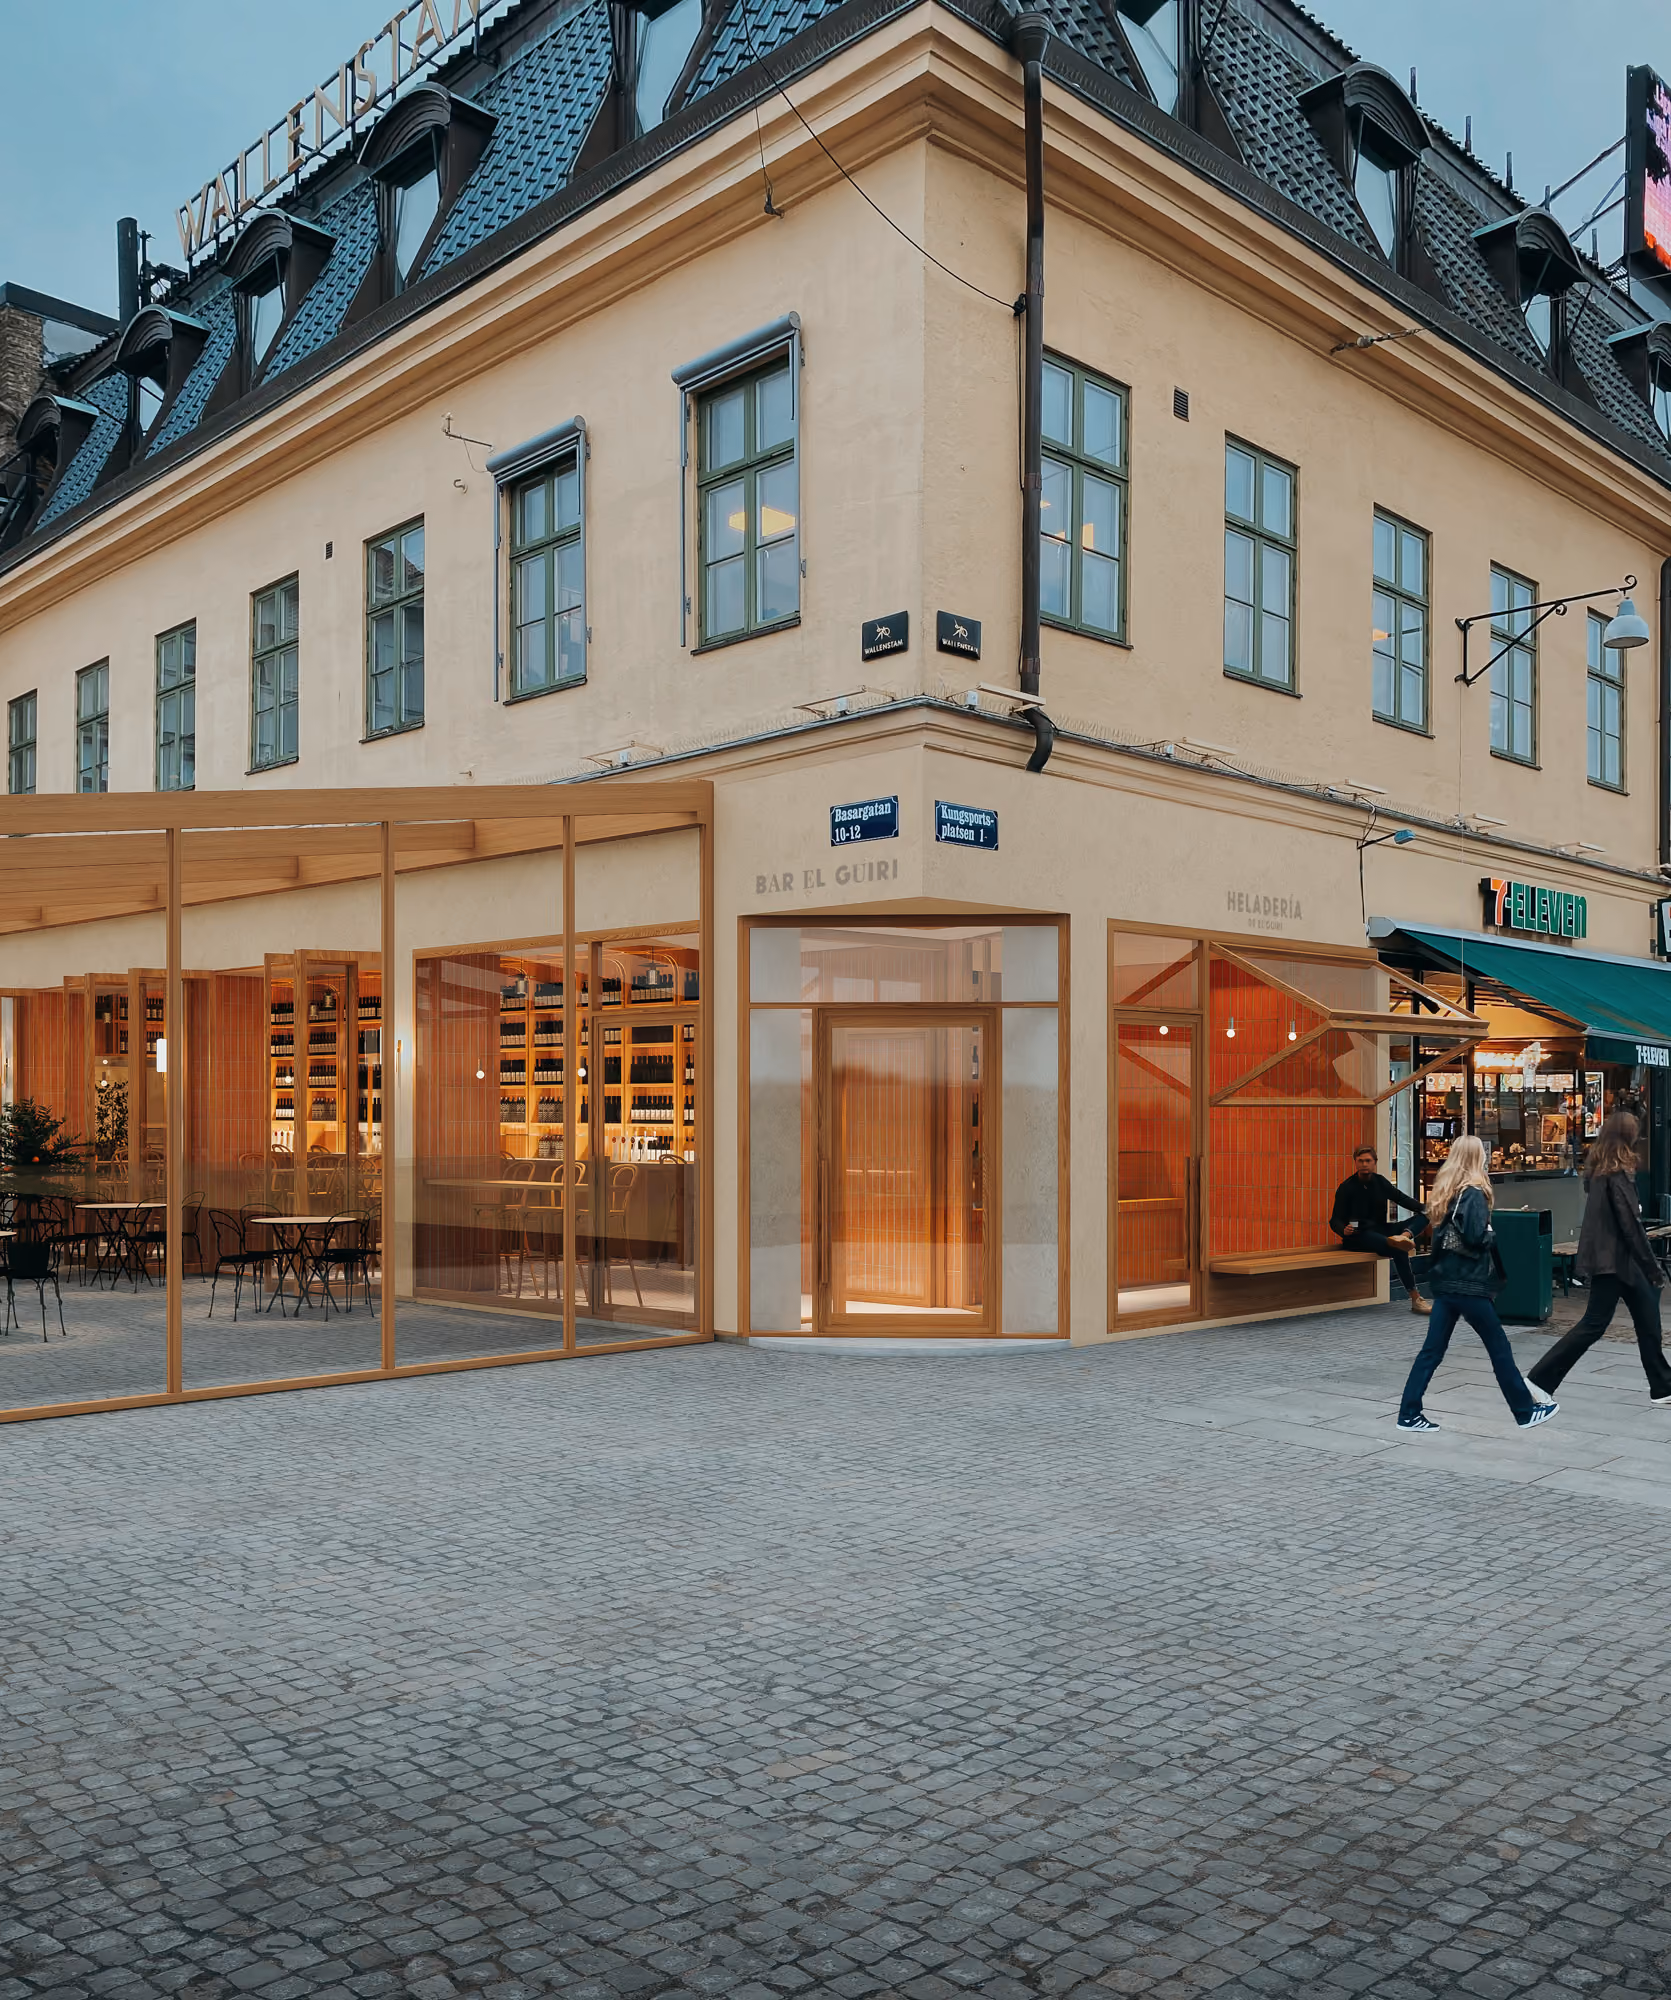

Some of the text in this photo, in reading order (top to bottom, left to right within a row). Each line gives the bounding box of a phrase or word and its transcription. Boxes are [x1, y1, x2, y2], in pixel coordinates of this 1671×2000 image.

[864, 639, 904, 655] WALLENSTAM
[835, 802, 891, 822] Basargatan
[941, 805, 994, 827] Kungsports-
[834, 825, 861, 842] 10-12
[941, 823, 975, 841] platsen
[755, 872, 794, 895] BAR
[803, 868, 826, 890] EL
[1227, 890, 1303, 920] HELADERÍA
